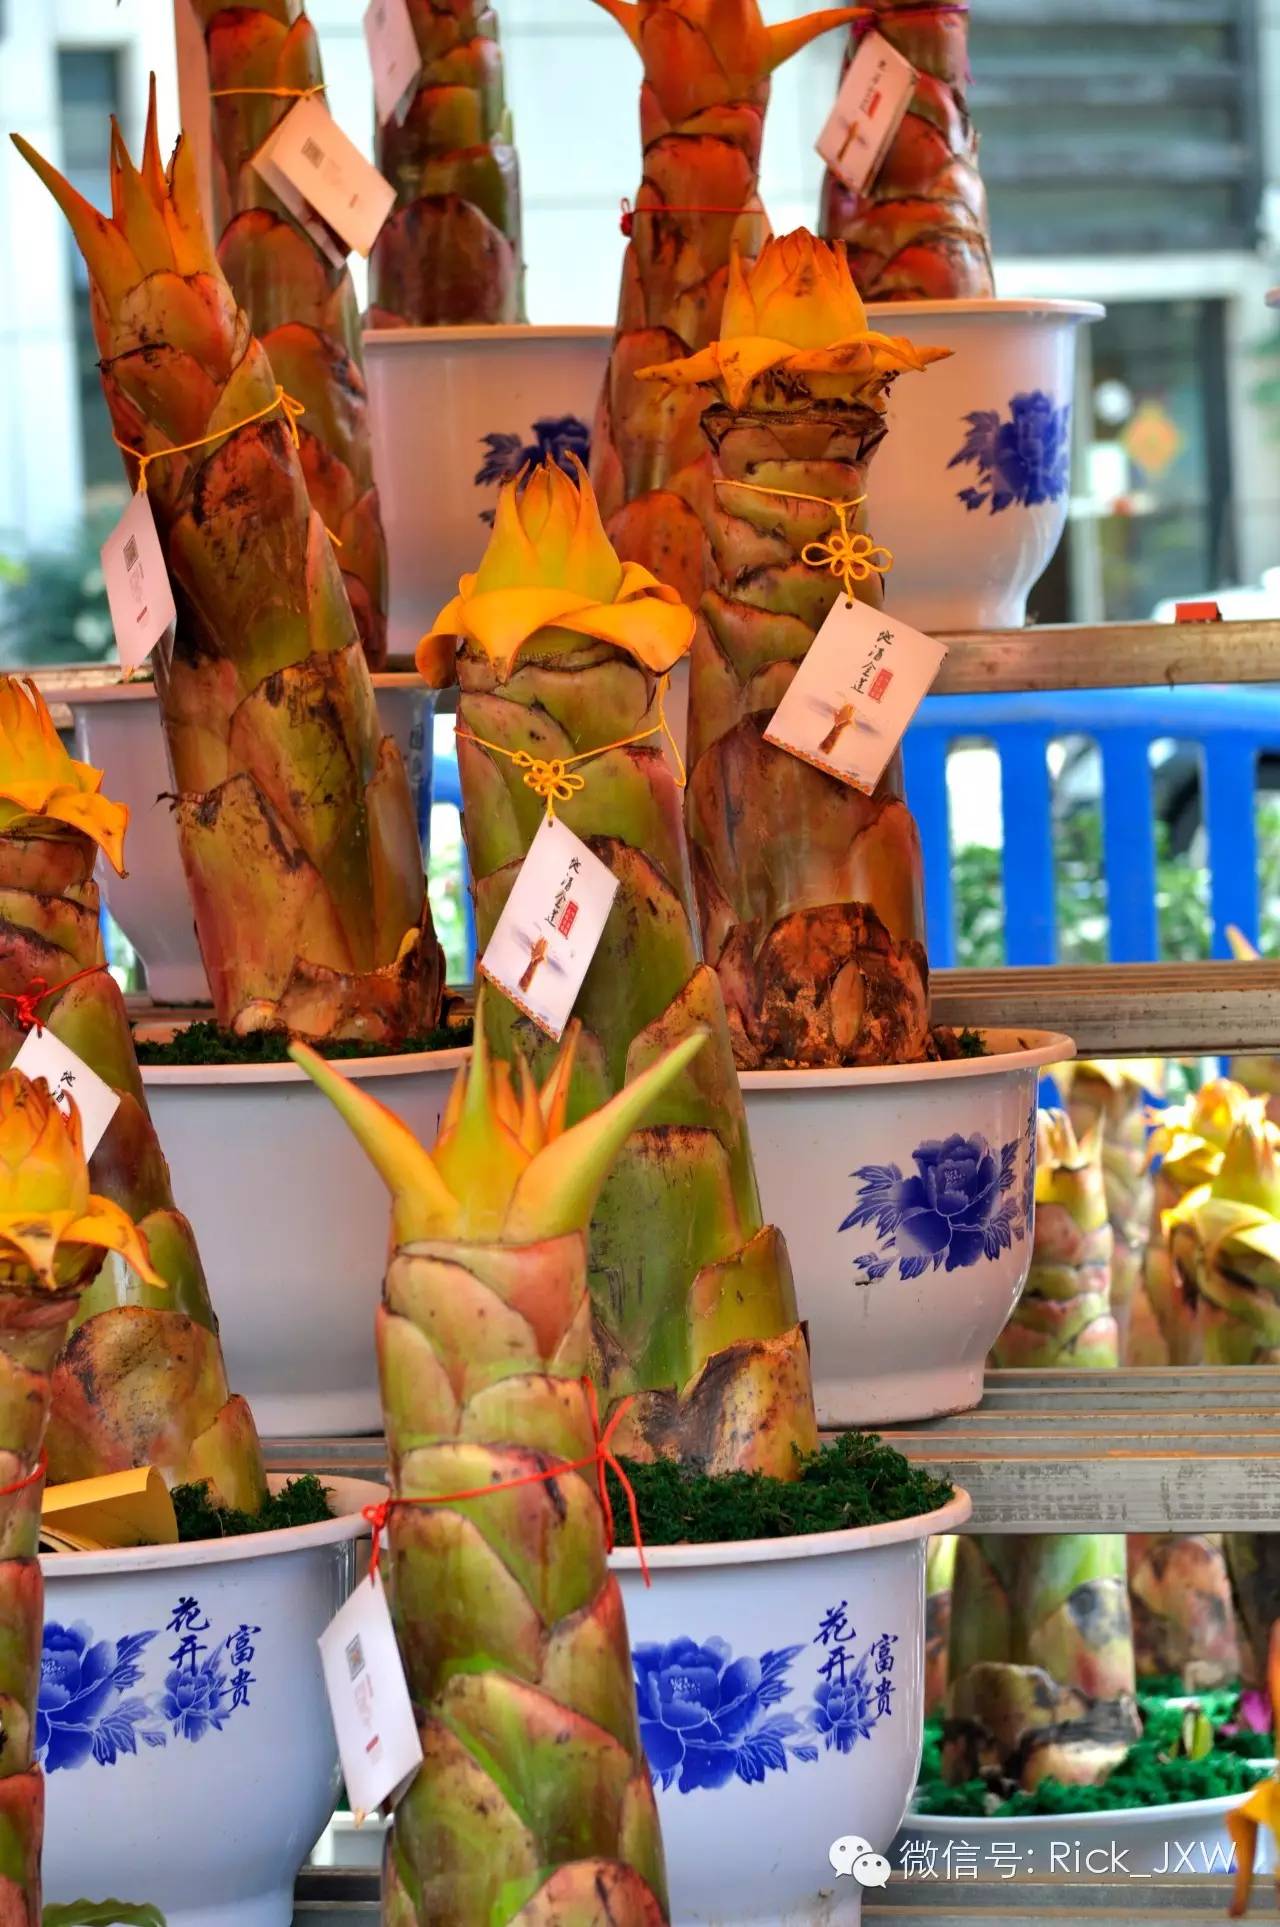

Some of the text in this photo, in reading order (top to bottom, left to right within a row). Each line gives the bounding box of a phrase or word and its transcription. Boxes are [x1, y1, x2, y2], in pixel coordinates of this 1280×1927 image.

[166, 1596, 211, 1677] 花开
[219, 1623, 262, 1713] 富贵
[813, 1600, 857, 1688] 花开
[867, 1633, 900, 1720] 富贵
